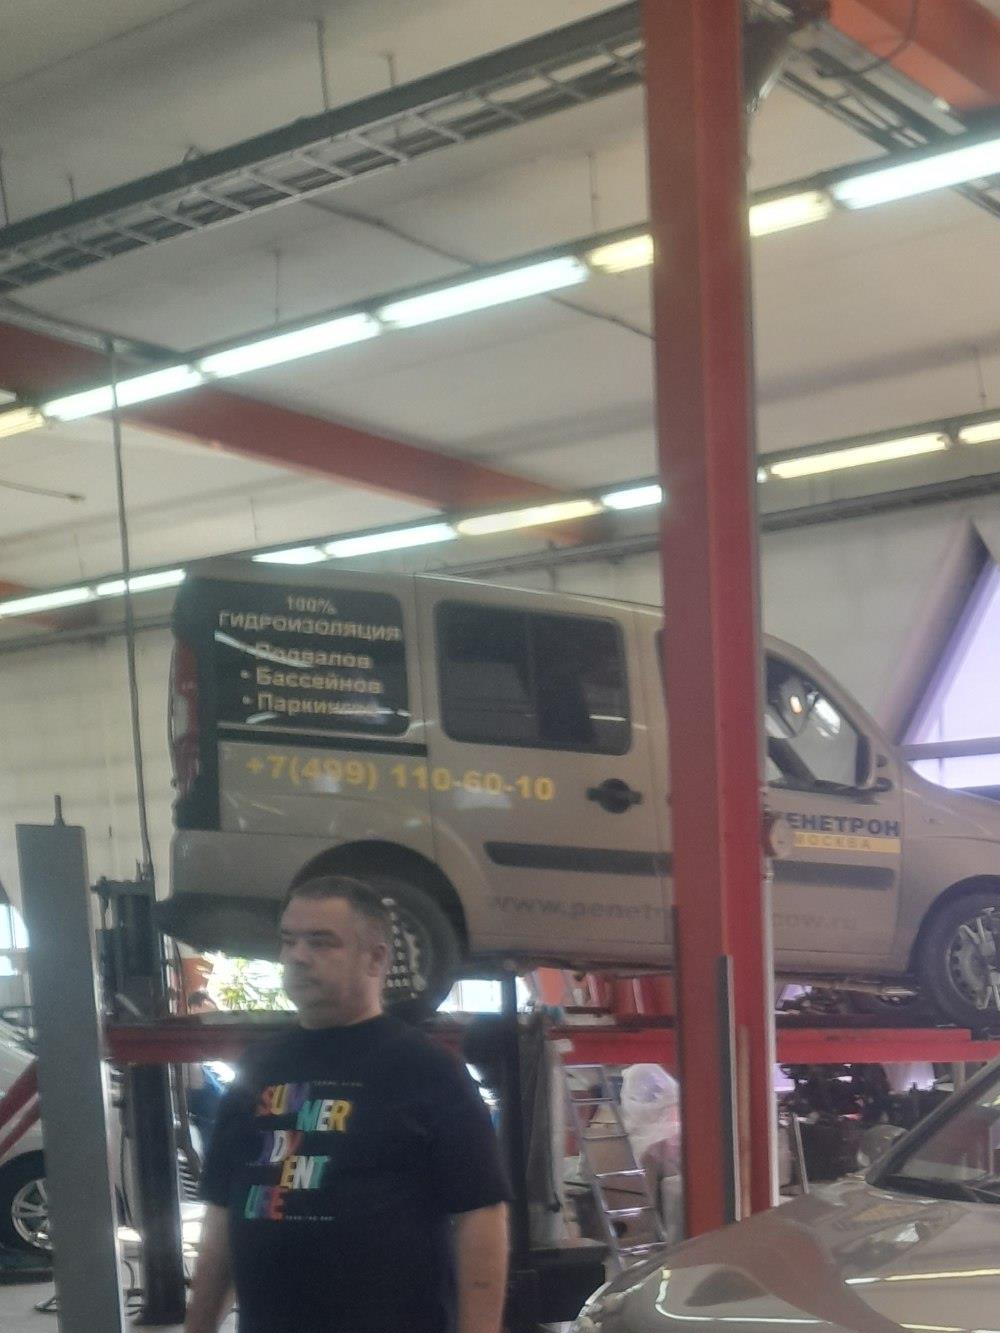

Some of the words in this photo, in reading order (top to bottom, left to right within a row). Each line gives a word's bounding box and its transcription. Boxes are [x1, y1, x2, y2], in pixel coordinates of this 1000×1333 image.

[288, 595, 337, 615] 100%
[218, 610, 400, 641] ГИДРОИЗОЛЯЦИЯ
[256, 667, 384, 694] Бассейнов
[246, 755, 379, 791] +7(499)
[391, 762, 557, 801] 110-60-10
[785, 811, 900, 837] ЕНЕТРОН
[279, 1154, 332, 1190] ENT
